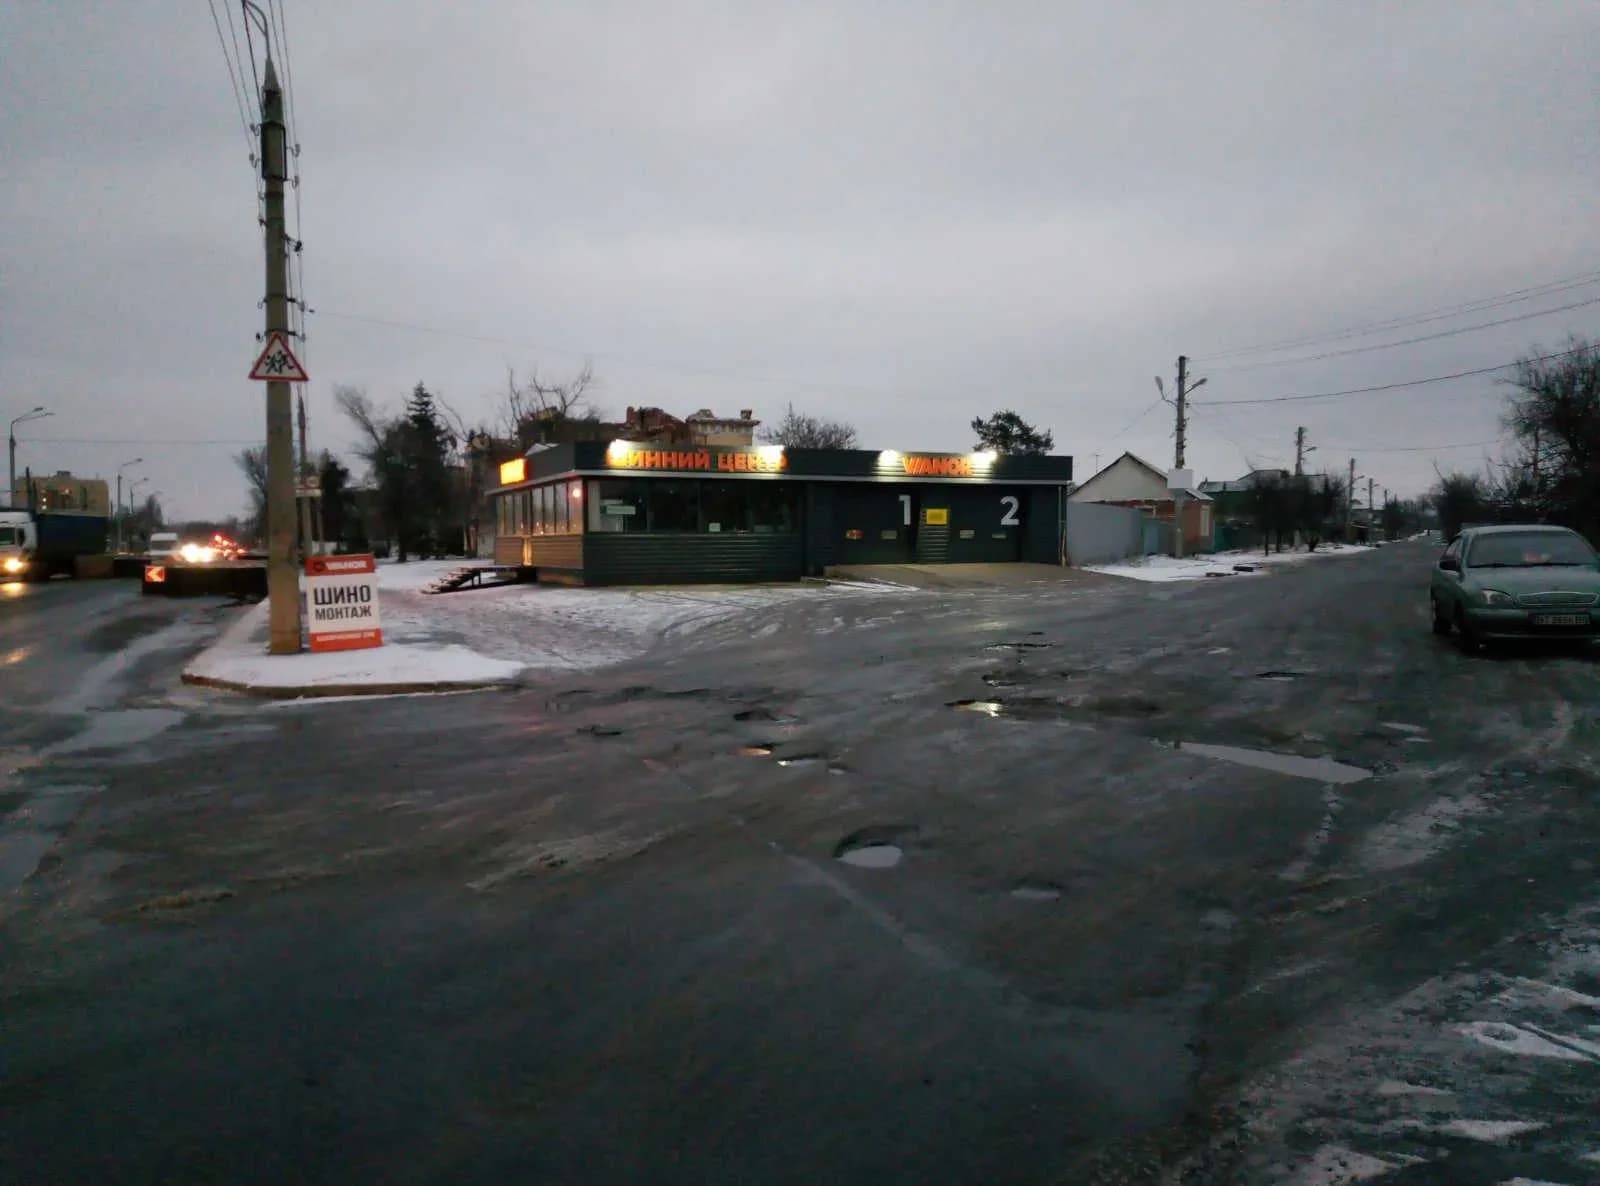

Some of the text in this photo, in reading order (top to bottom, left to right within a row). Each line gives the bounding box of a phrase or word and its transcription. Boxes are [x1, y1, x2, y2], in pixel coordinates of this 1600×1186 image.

[607, 448, 788, 472] ИННИЙ ЦЕН
[898, 494, 911, 525] 1
[1000, 495, 1020, 526] 2
[313, 585, 371, 605] ШИНО
[315, 605, 372, 621] МОНТАЖ
